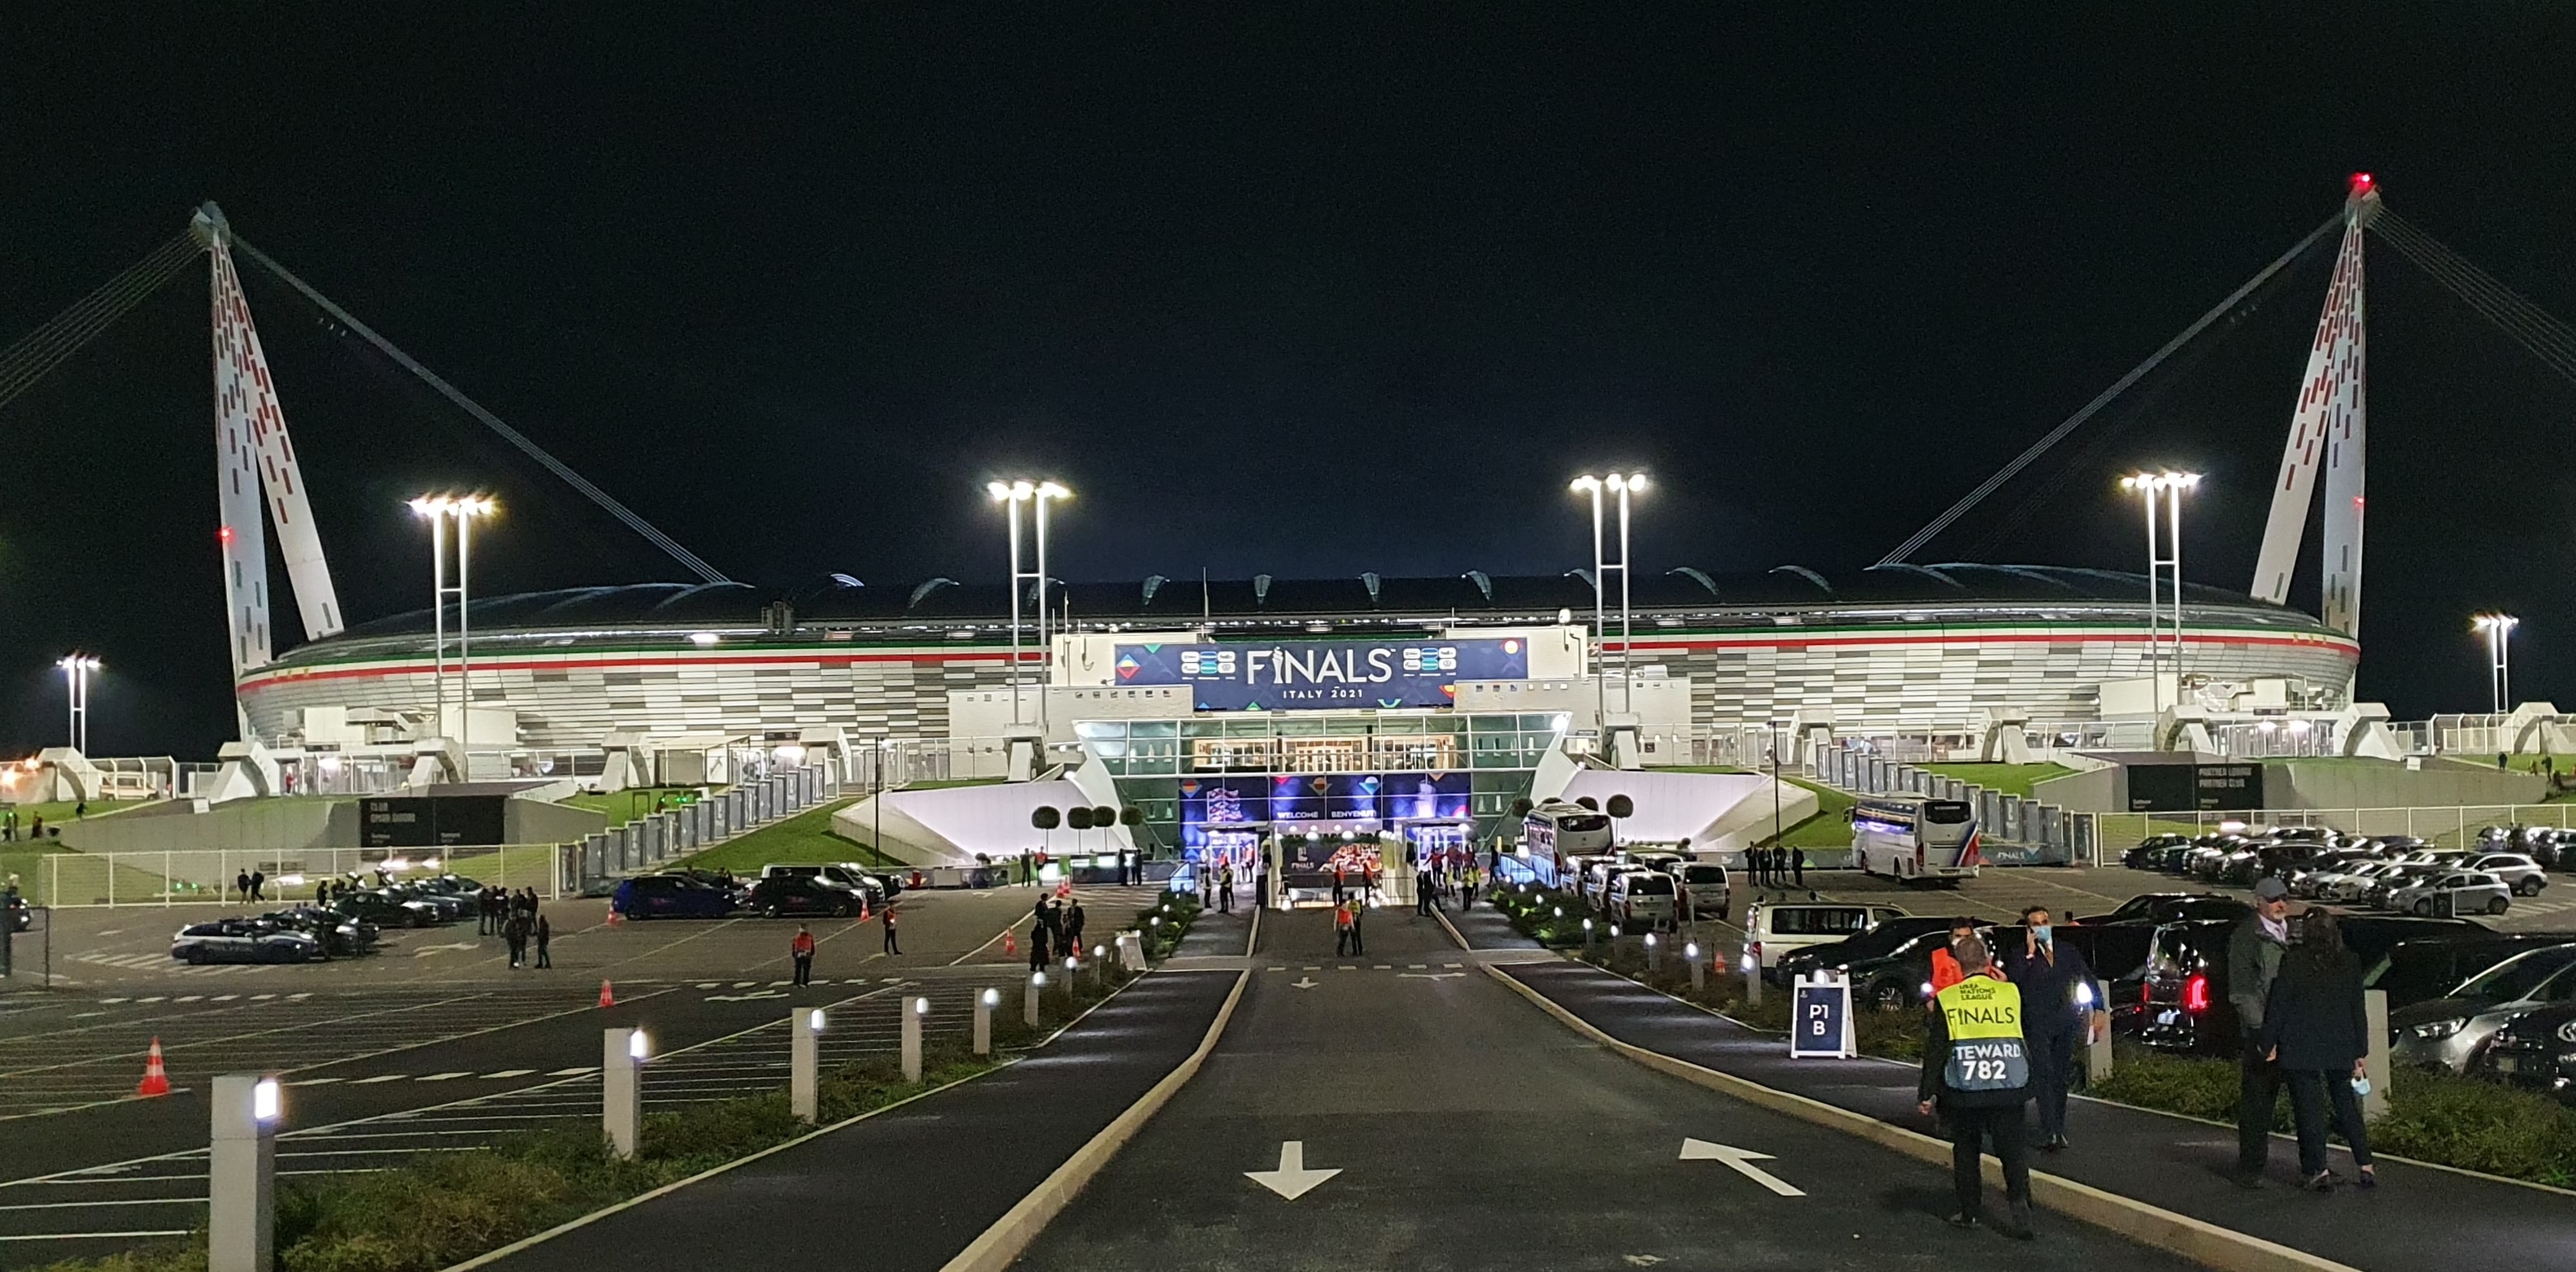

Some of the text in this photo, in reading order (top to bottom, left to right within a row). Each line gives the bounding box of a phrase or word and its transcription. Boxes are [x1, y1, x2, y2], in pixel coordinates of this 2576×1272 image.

[1247, 647, 1393, 684] FINALS
[1283, 689, 1362, 699] ITALY 2021
[1810, 1004, 1828, 1019] P1
[1946, 1007, 2015, 1025] FINALS
[1813, 1021, 1826, 1035] B
[1955, 1043, 2021, 1061] TEWARD
[1963, 1060, 2007, 1080] 782
